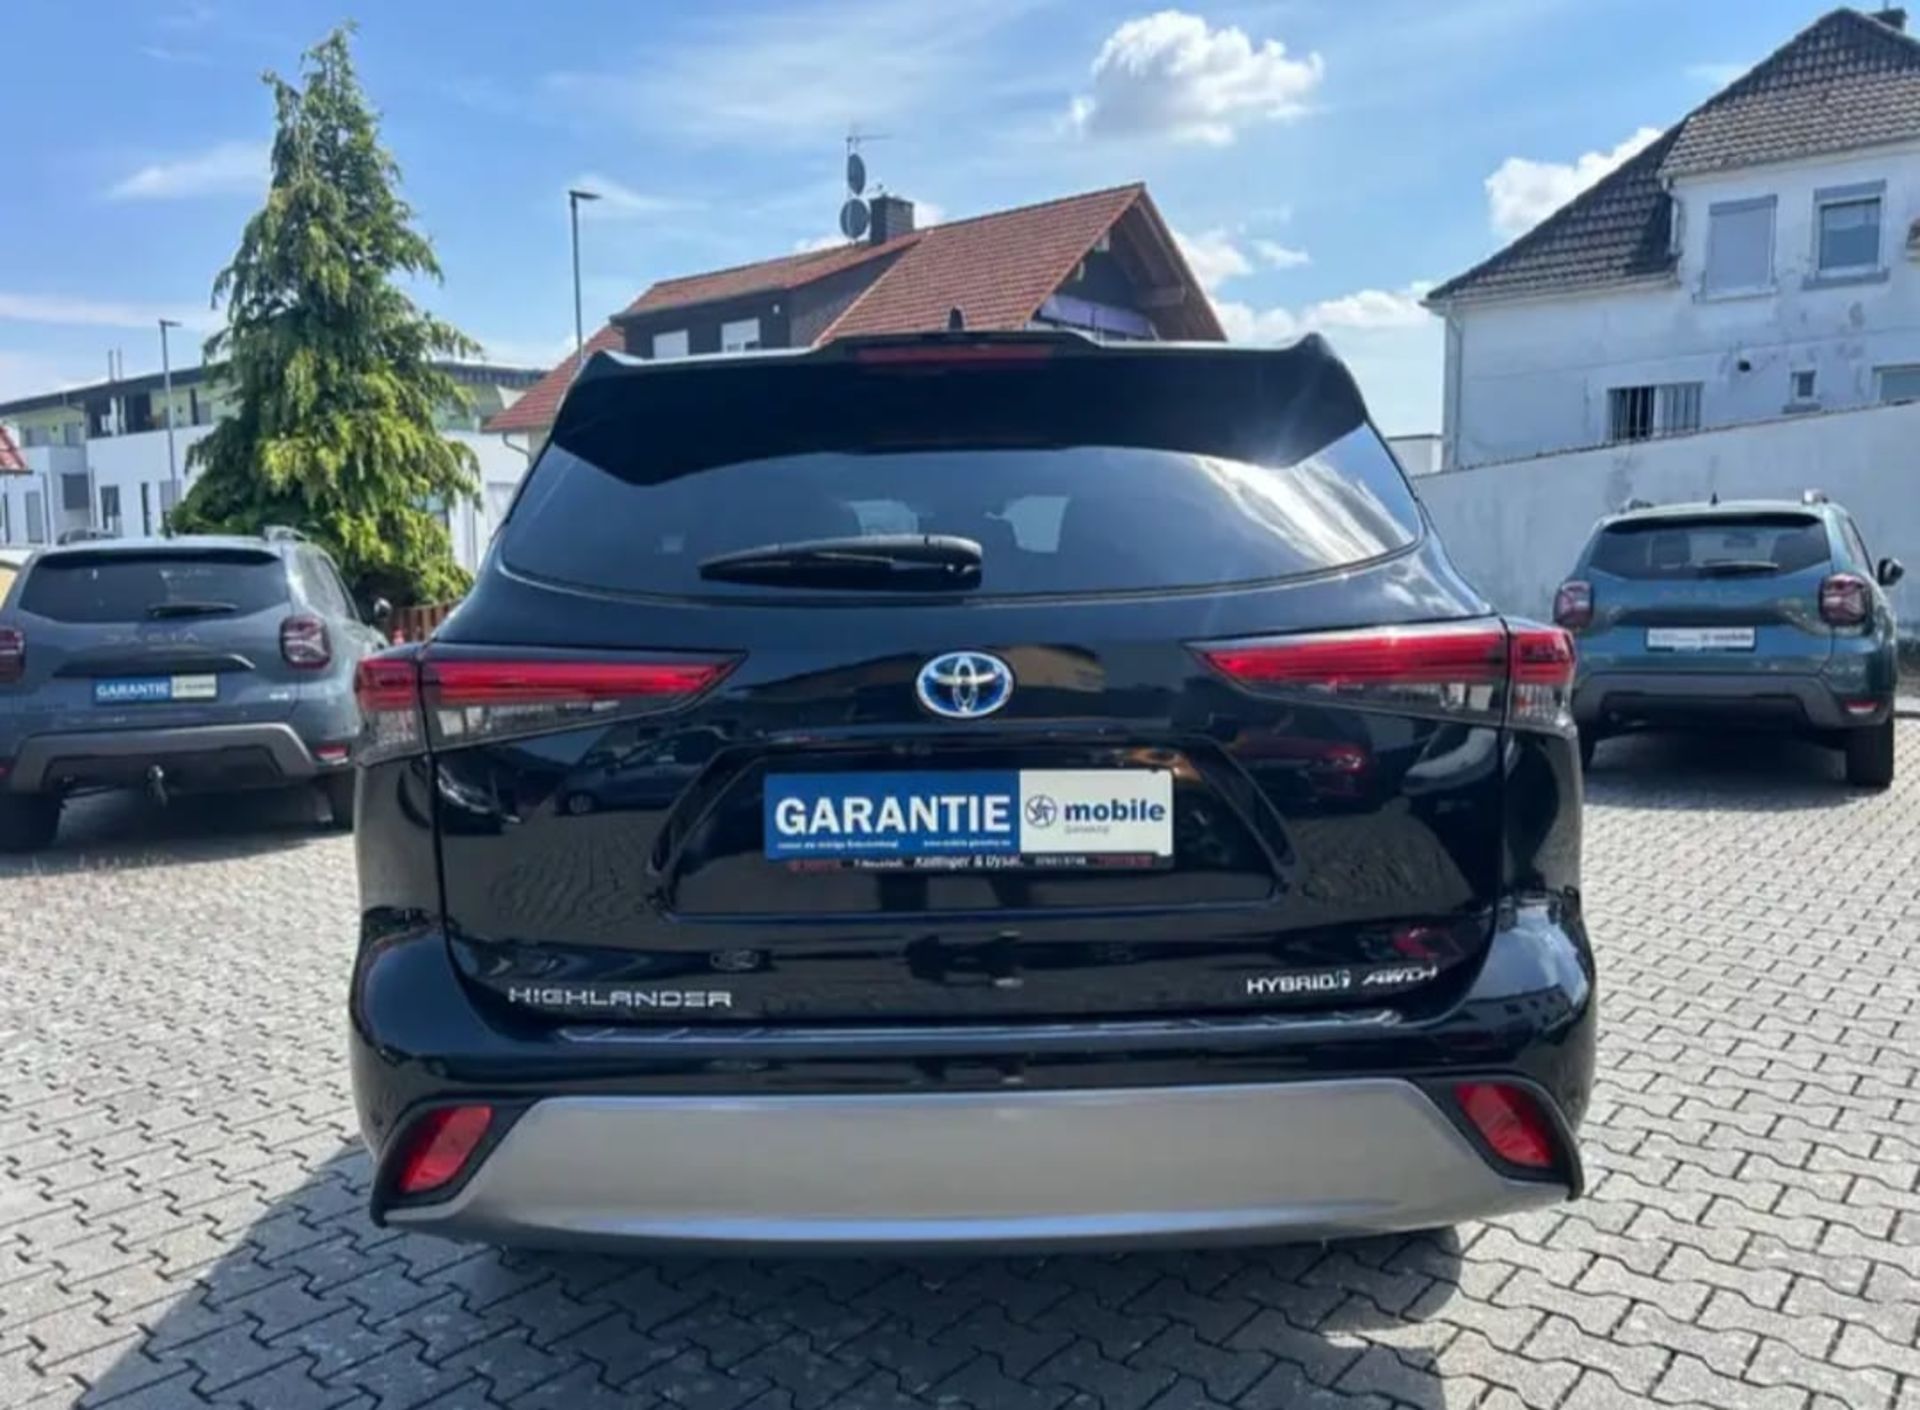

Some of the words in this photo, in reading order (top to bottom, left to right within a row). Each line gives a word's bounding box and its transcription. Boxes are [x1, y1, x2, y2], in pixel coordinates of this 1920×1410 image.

[775, 796, 1011, 835] GARANTIE
[1064, 798, 1166, 821] mobile
[1247, 974, 1337, 995] HYBRID
[508, 987, 732, 1008] HIGHLANDER
